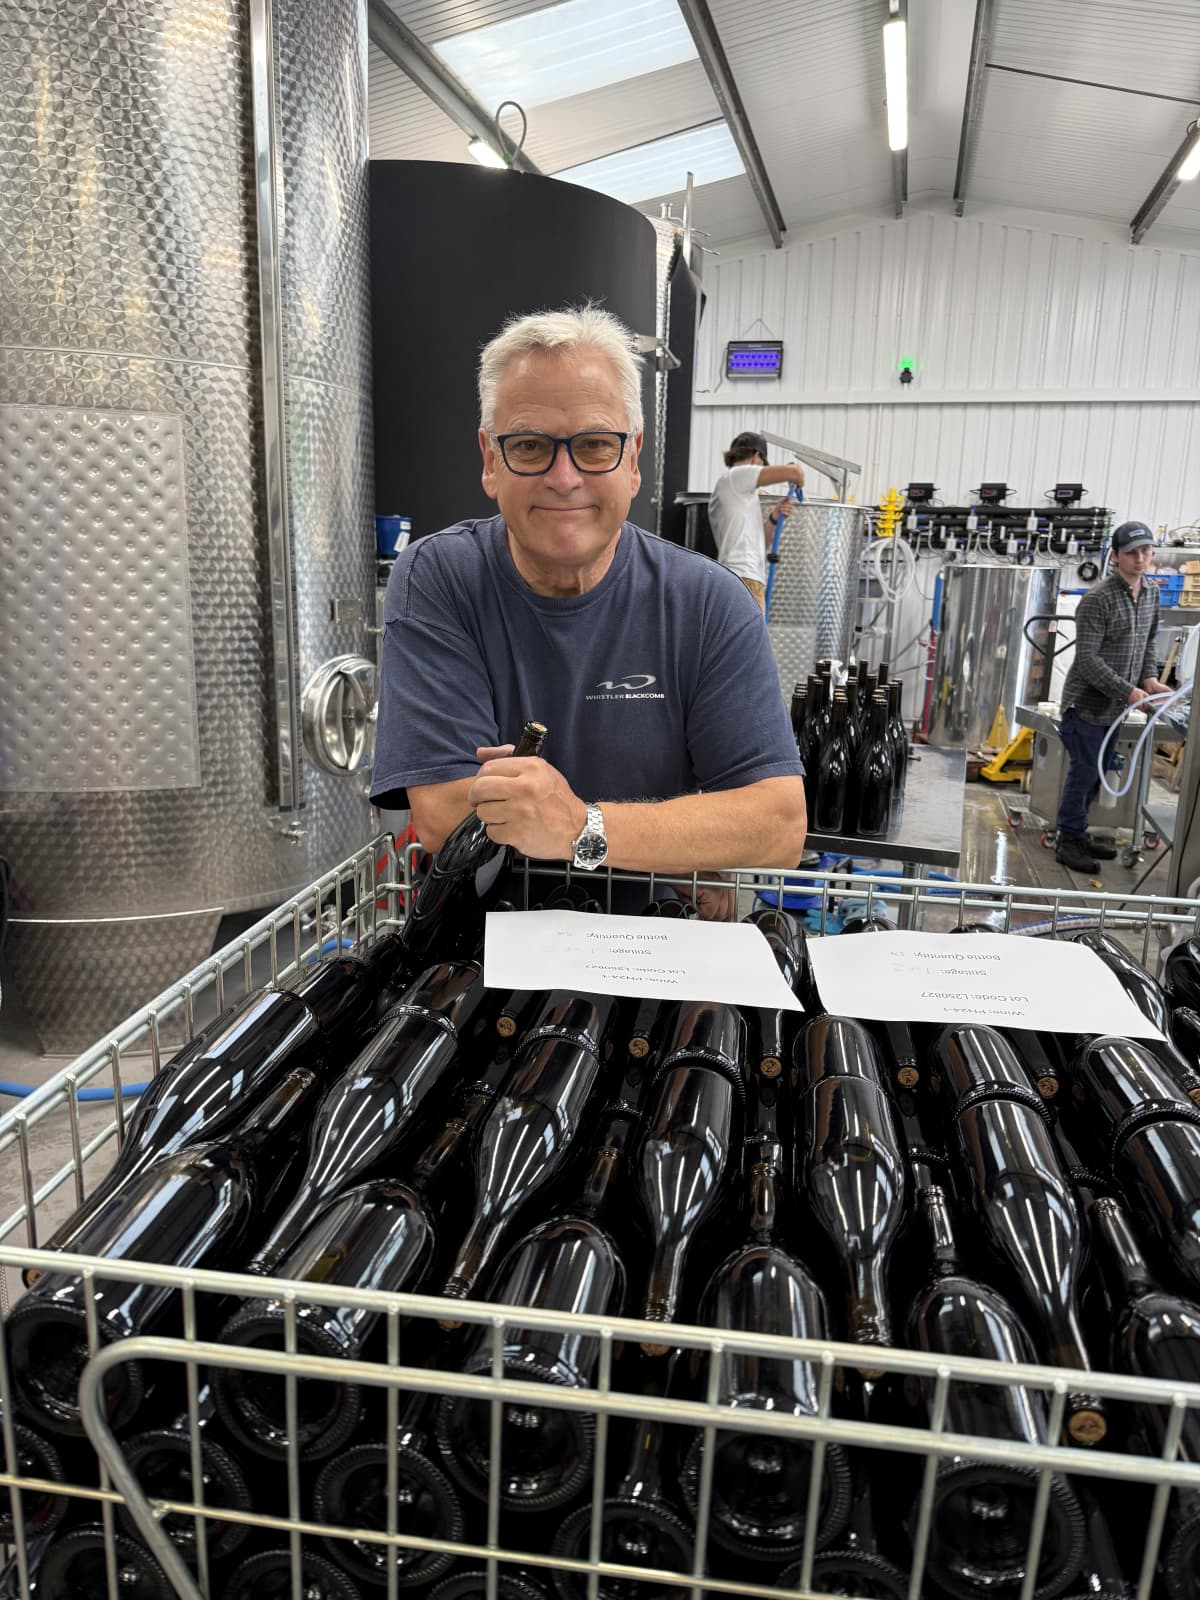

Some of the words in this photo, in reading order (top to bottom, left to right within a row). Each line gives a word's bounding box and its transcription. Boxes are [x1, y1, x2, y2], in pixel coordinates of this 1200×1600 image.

[586, 933, 634, 941] Quantity:
[913, 952, 965, 961] Quantity:
[921, 991, 969, 1000] L250827
[971, 994, 1006, 1002] Code:
